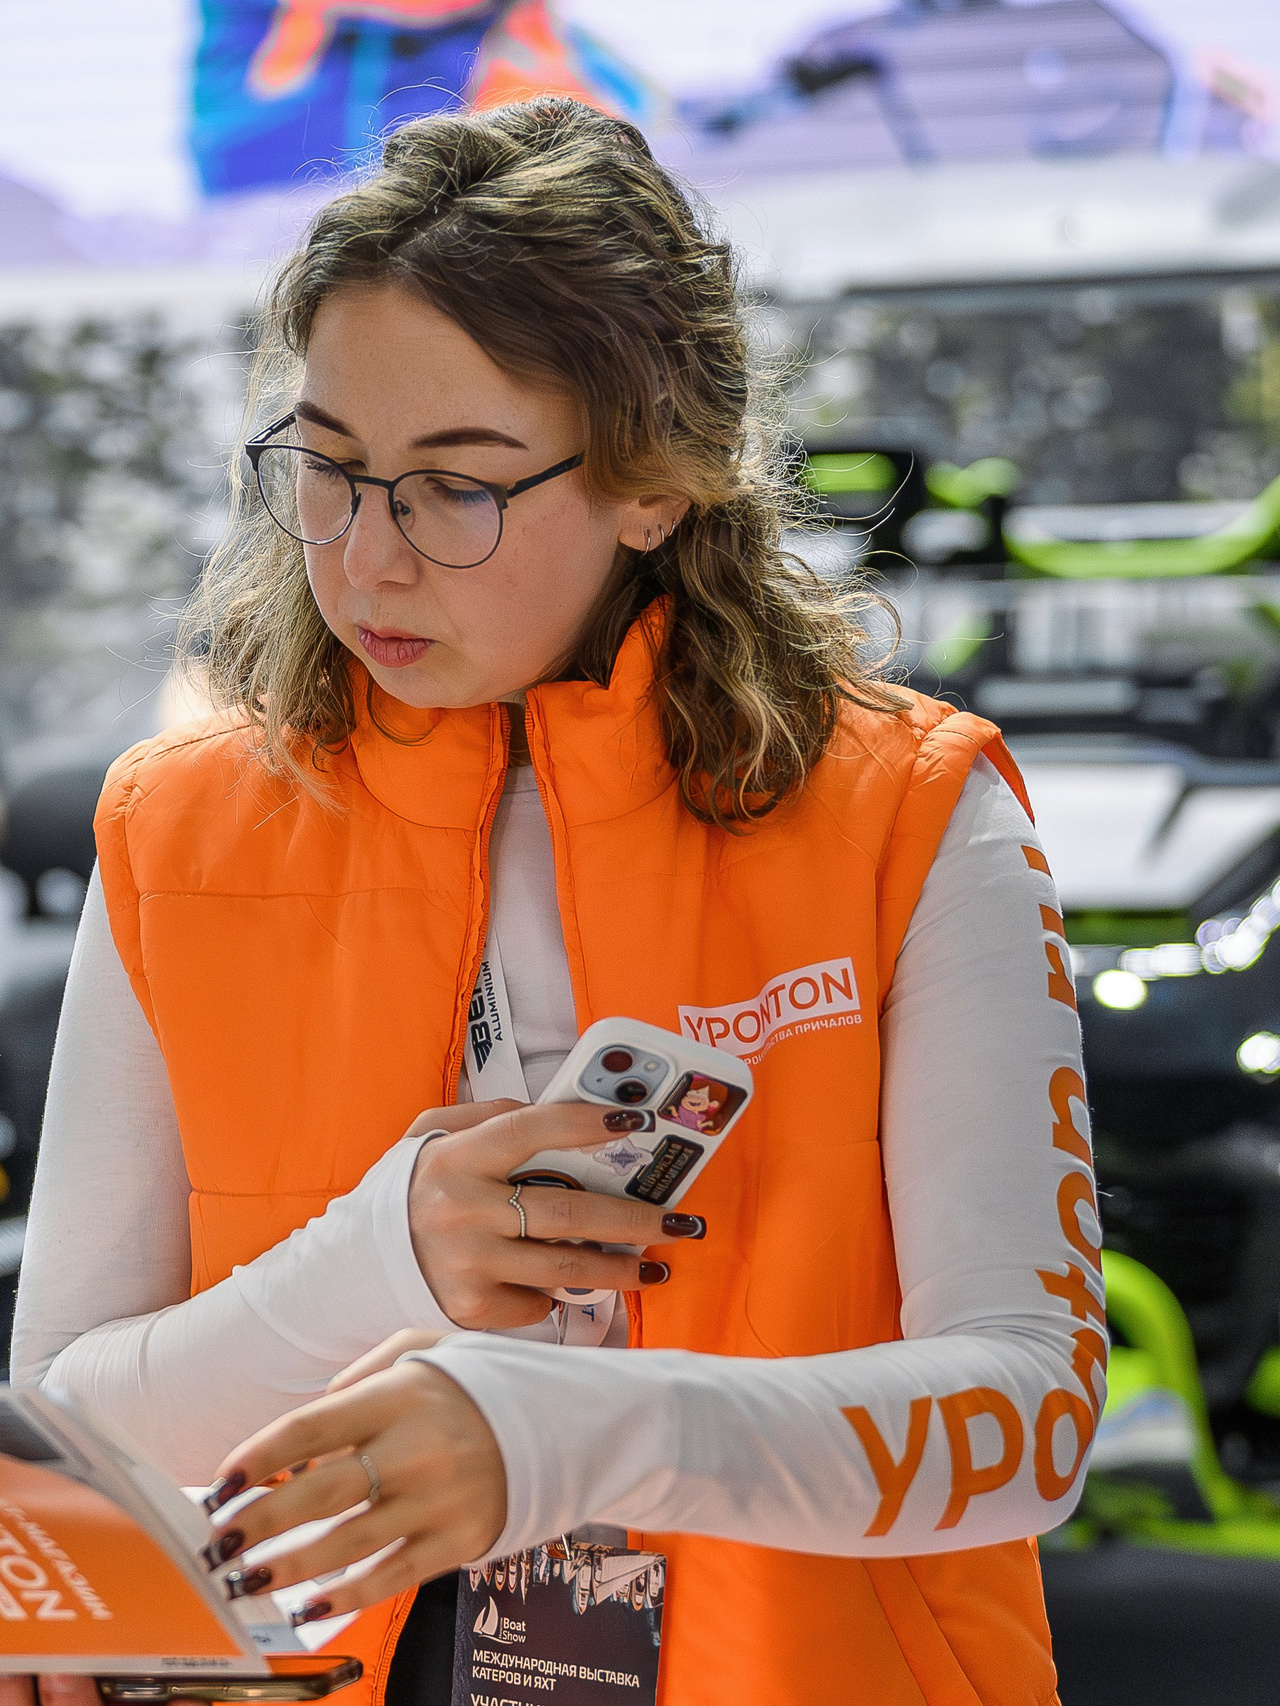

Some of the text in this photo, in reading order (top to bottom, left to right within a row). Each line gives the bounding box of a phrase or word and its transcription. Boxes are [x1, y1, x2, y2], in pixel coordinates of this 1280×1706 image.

[481, 960, 503, 1041] ALUMINIUM
[795, 1013, 862, 1035] ПРИЧАЛОВ
[503, 1617, 527, 1632] Boat
[502, 1630, 527, 1643] Show
[472, 1666, 557, 1691] КАТЕРОВ И ЯХТ
[473, 1648, 640, 1688] МЕЖДУНАРОДНАЯ ВЫСТАВКА
